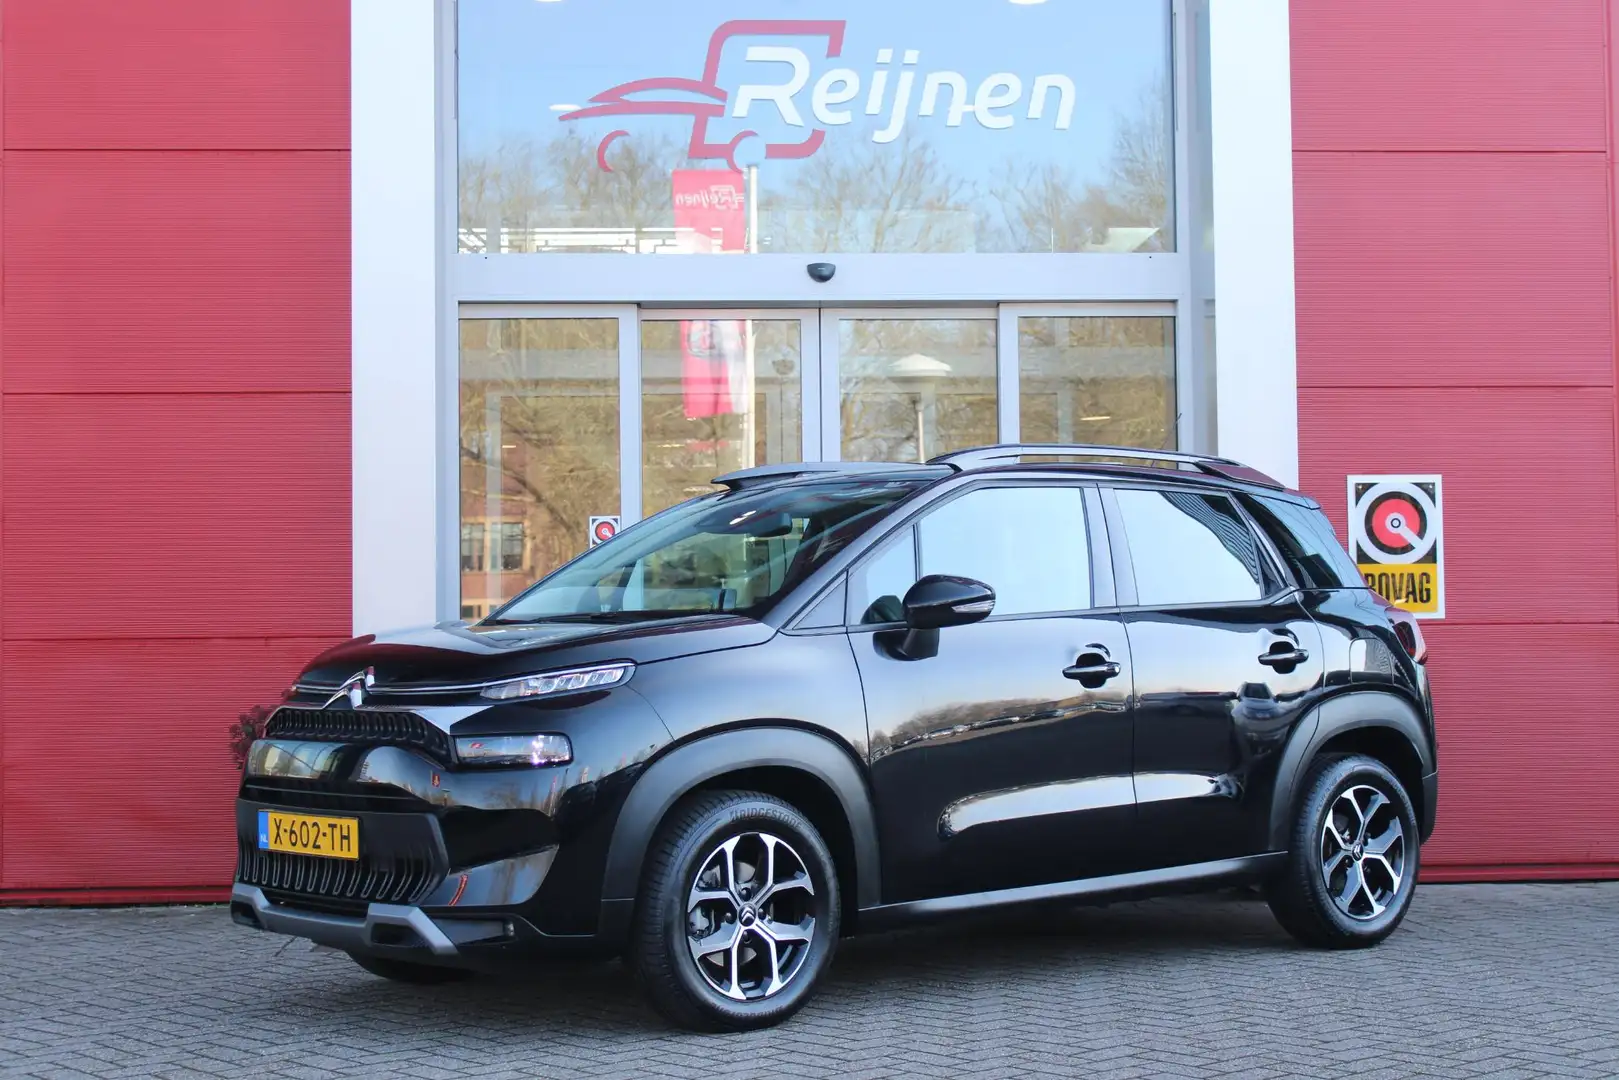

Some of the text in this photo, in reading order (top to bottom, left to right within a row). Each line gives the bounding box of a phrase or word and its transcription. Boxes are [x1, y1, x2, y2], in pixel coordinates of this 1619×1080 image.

[732, 46, 1077, 143] Reijnen
[260, 834, 269, 843] NL
[274, 818, 351, 852] X-602-TH
